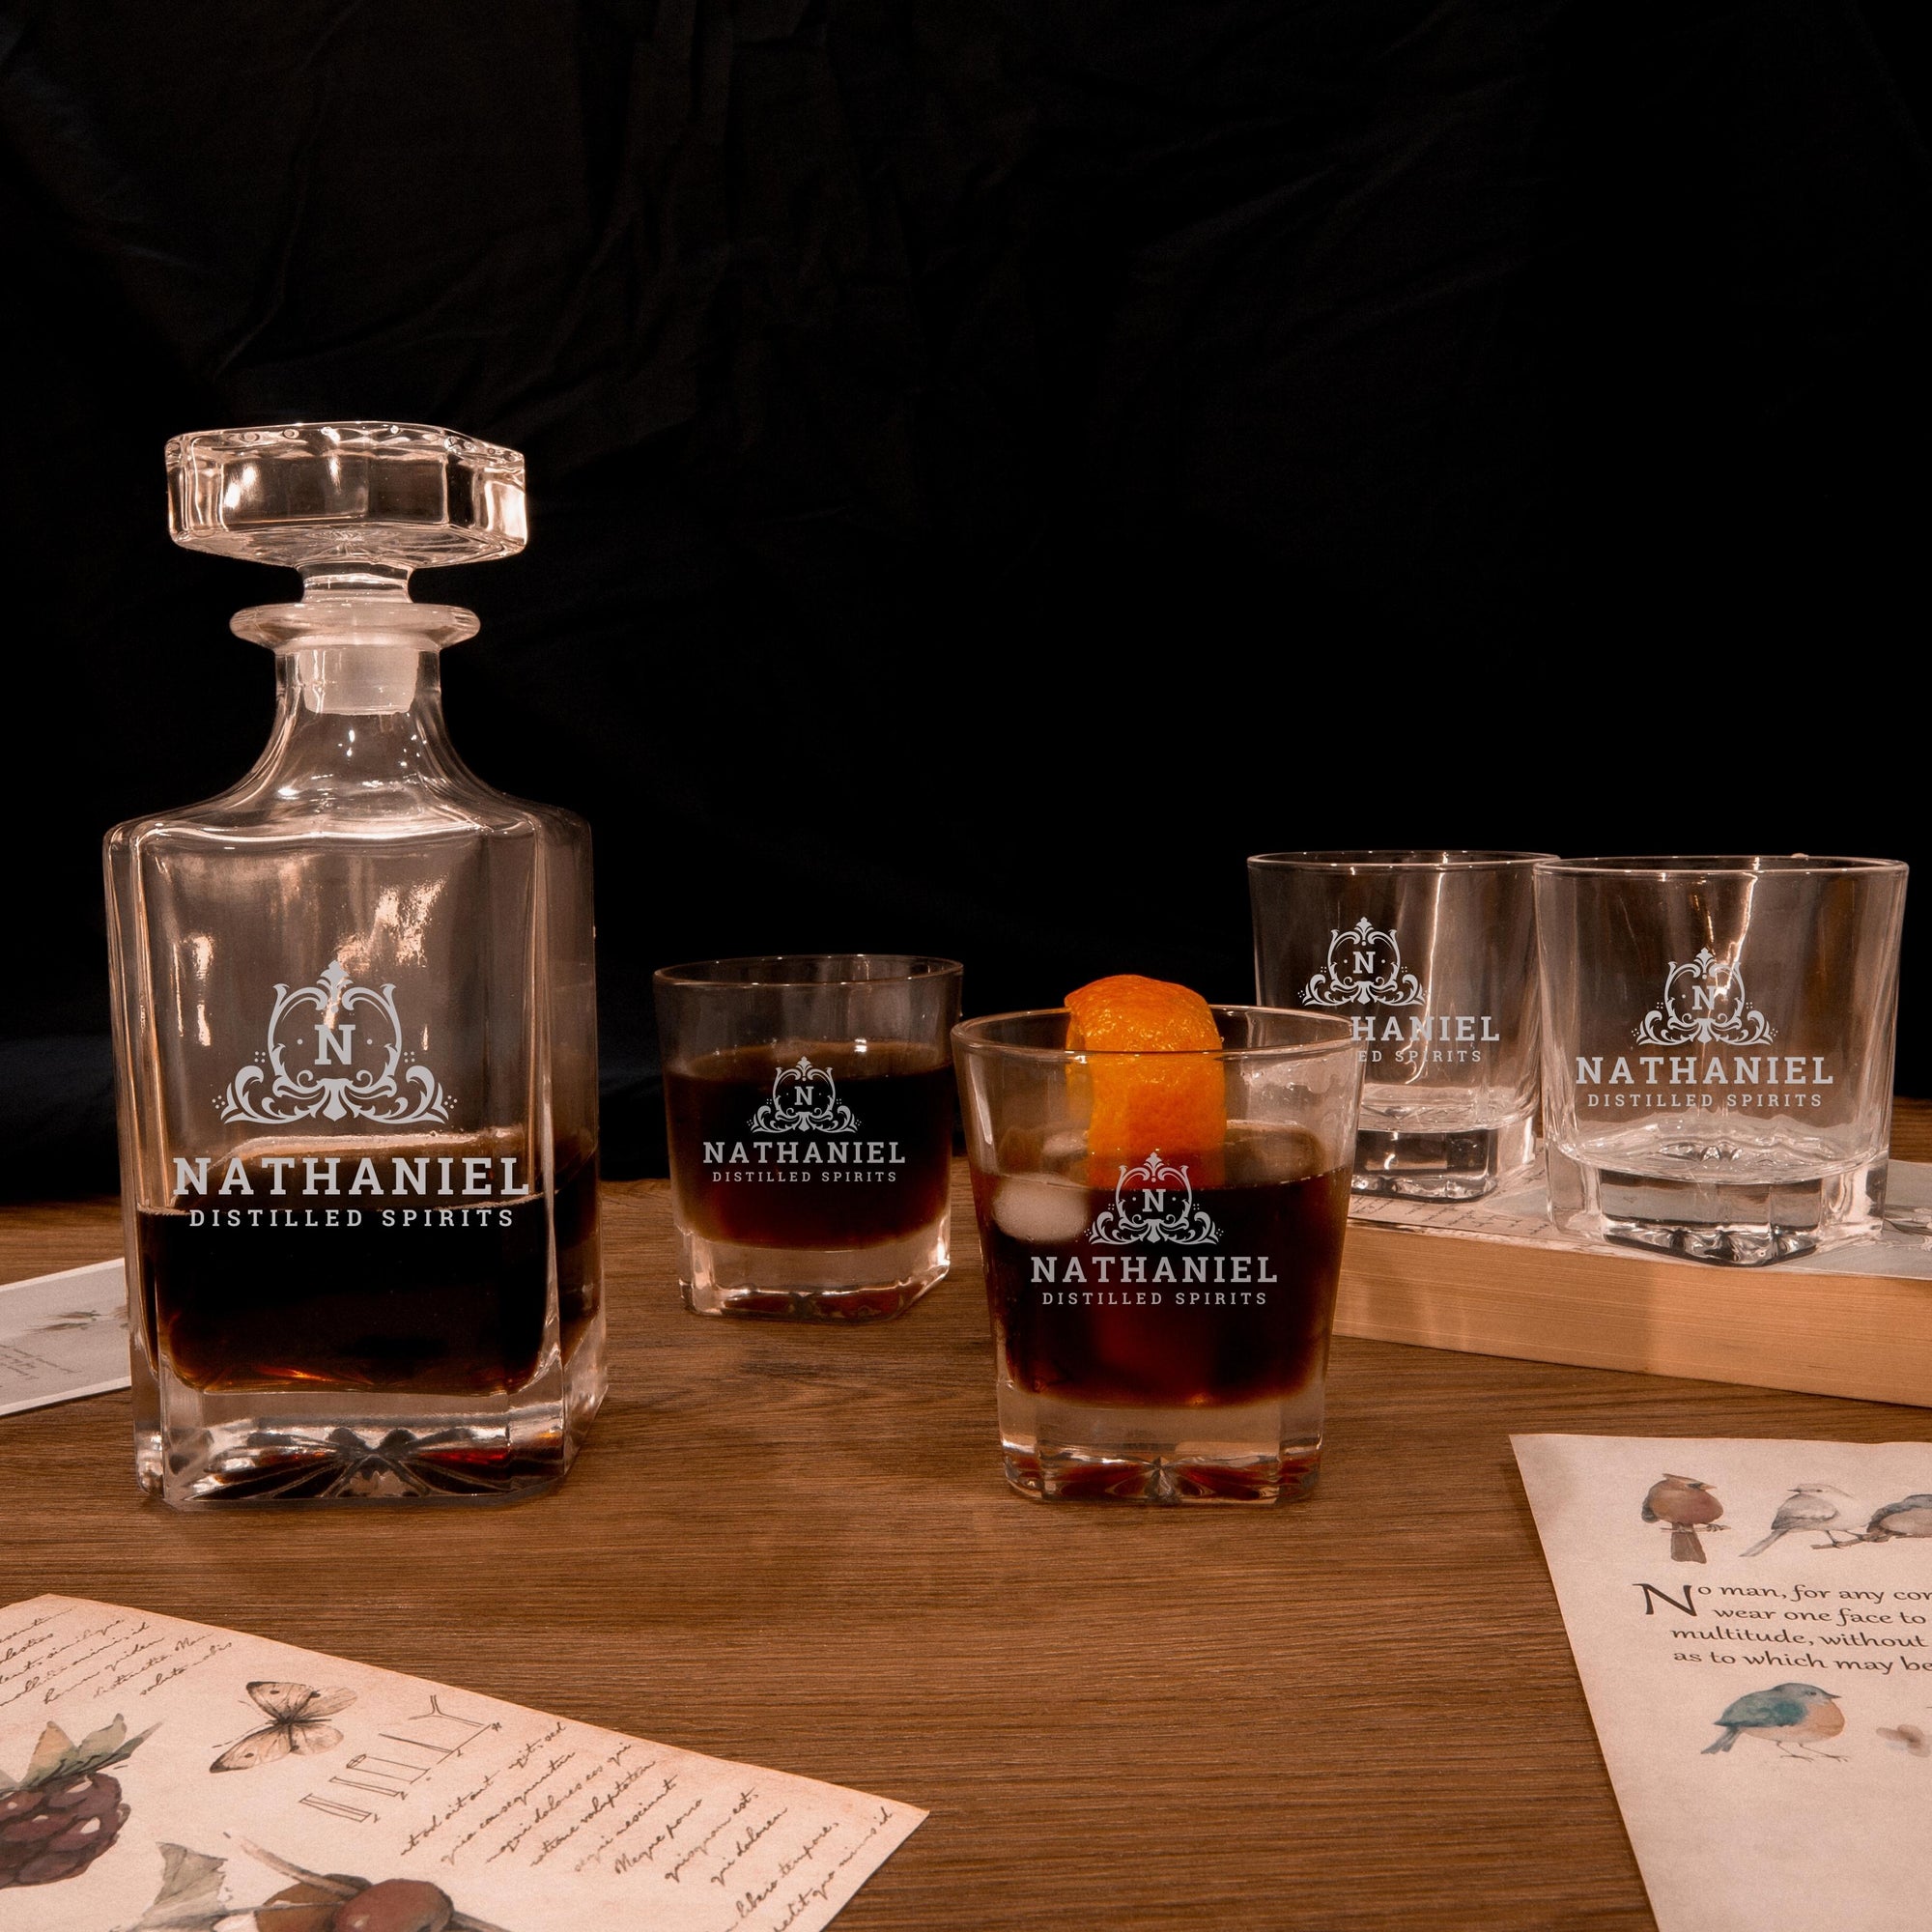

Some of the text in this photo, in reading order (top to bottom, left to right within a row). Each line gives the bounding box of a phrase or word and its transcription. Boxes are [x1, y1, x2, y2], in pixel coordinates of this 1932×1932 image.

[1352, 951, 1376, 975] N
[1691, 985, 1716, 1010] N
[1350, 1015, 1500, 1041] HANIEL
[314, 1024, 356, 1065] N
[1395, 1050, 1482, 1063] SPIRITS
[1576, 1056, 1833, 1085] NATHANIEL
[794, 1086, 814, 1106] N
[1587, 1094, 1822, 1107] DISTILLED SPIRITS
[702, 1141, 906, 1164] NATHANIEL
[173, 1157, 529, 1196] NATHANIEL
[712, 1171, 897, 1182] DISTILLED SPIRITS
[1142, 1188, 1166, 1212] N
[189, 1208, 513, 1227] DISTILLED SPIRITS
[1031, 1256, 1277, 1283] NATHANIEL
[1042, 1293, 1266, 1305] DISTILLED SPIRITS
[1718, 1586, 1787, 1599] man,
[1791, 1584, 1832, 1602] for
[1838, 1589, 1885, 1604] any
[1713, 1607, 1926, 1626] wear one face to
[1670, 1626, 1929, 1648] multitude, without
[1674, 1651, 1932, 1675] as to which may be
